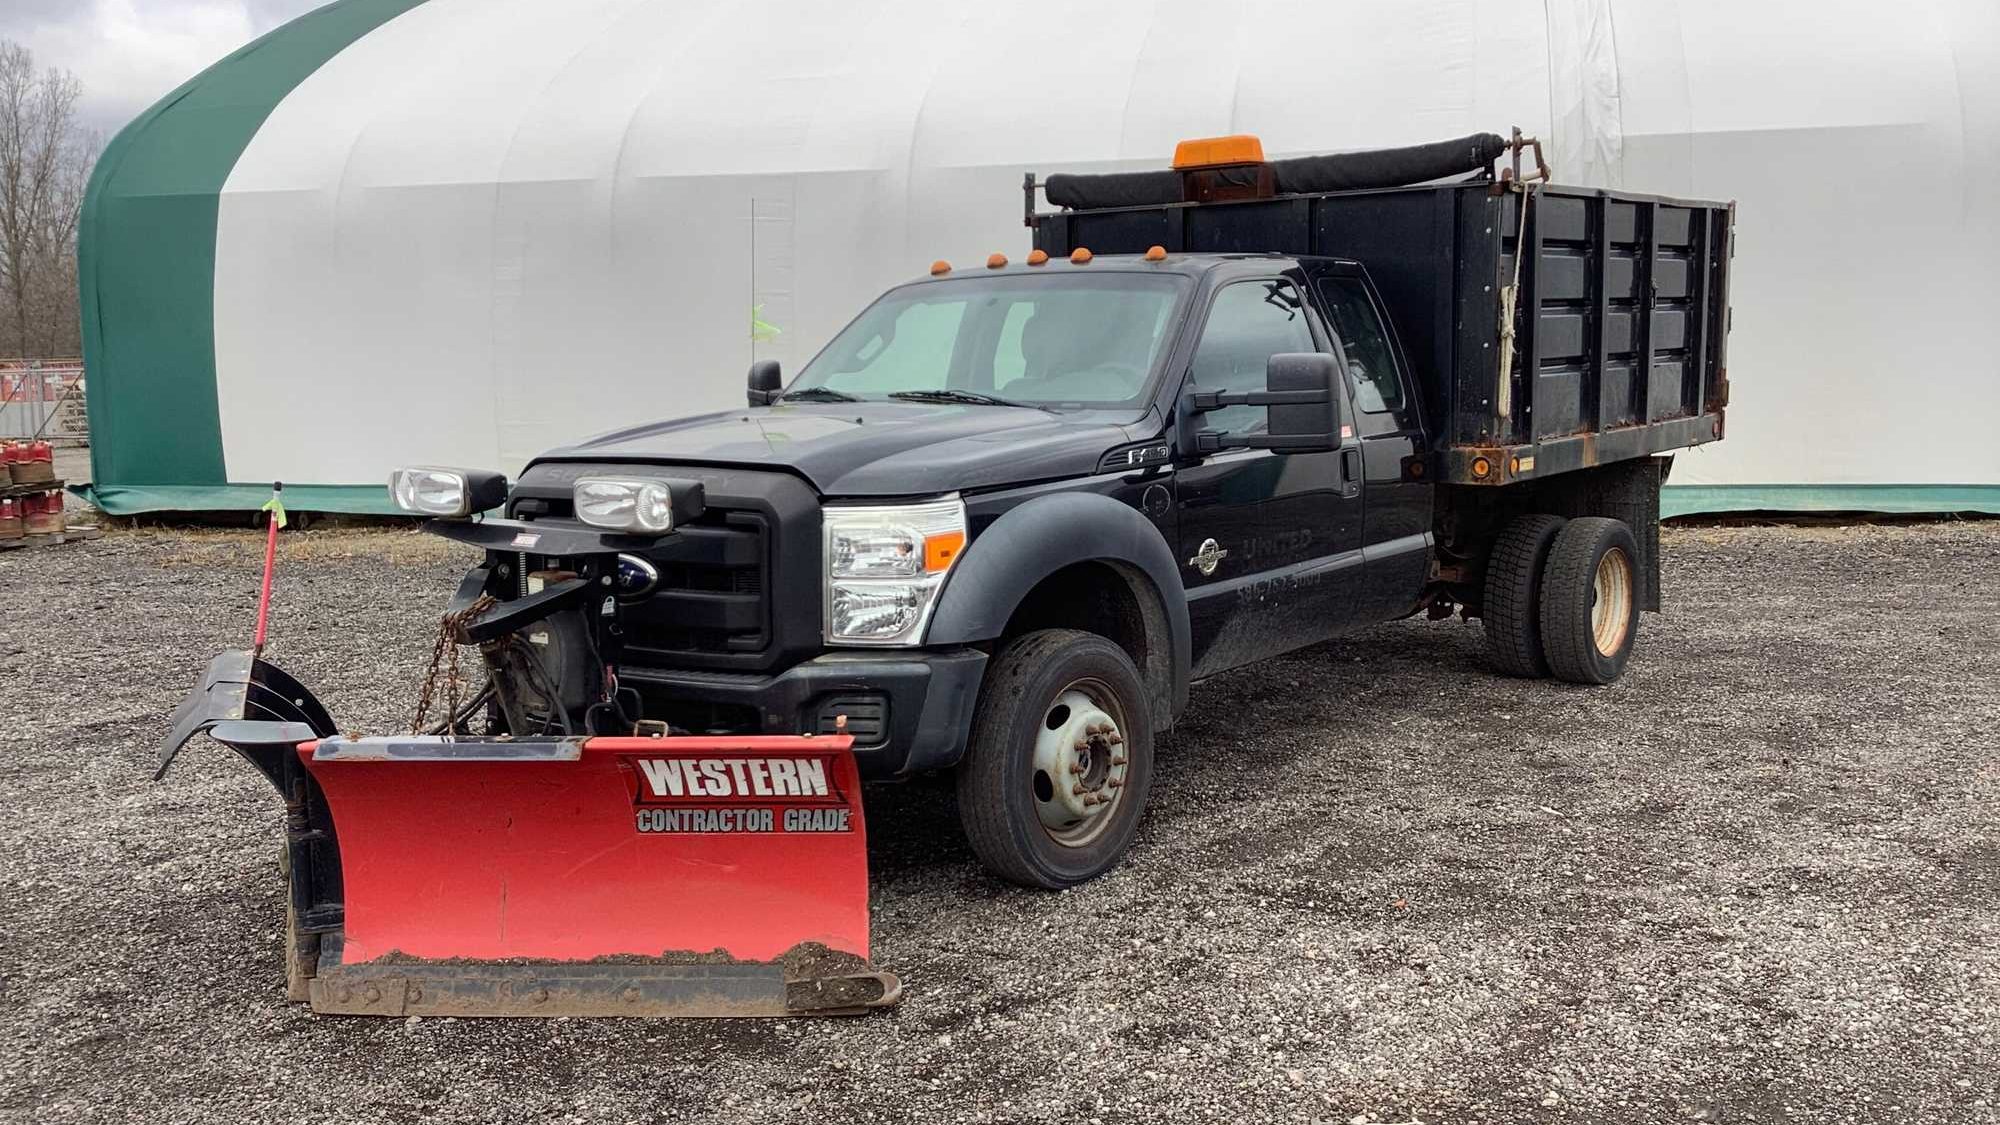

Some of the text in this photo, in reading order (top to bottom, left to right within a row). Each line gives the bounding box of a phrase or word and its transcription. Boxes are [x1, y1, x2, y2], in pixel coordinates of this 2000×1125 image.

[637, 758, 829, 796] WESTERN
[637, 808, 850, 833] CONTRACTOR GRADE
